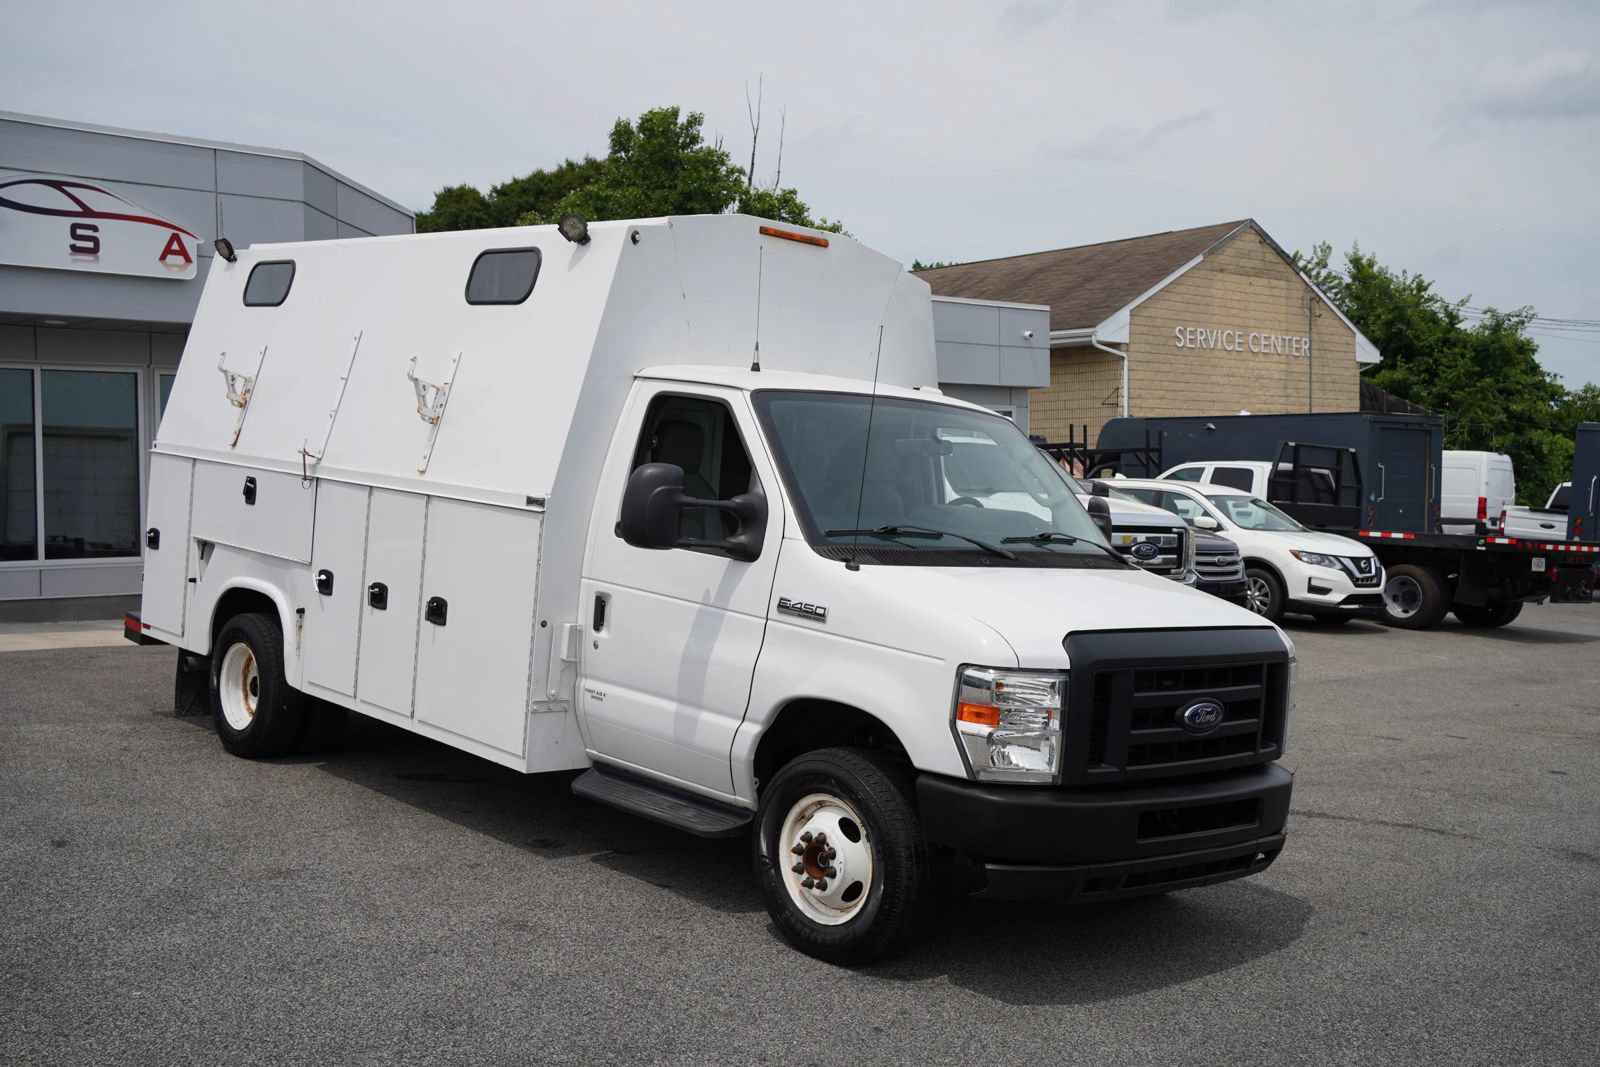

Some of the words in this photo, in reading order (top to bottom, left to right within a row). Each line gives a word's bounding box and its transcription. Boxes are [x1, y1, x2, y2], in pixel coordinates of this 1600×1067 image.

[69, 222, 100, 255] S
[158, 232, 193, 264] A
[1175, 326, 1244, 352] SERVICE
[1248, 332, 1311, 357] CENTER
[1195, 707, 1217, 723] Ford
